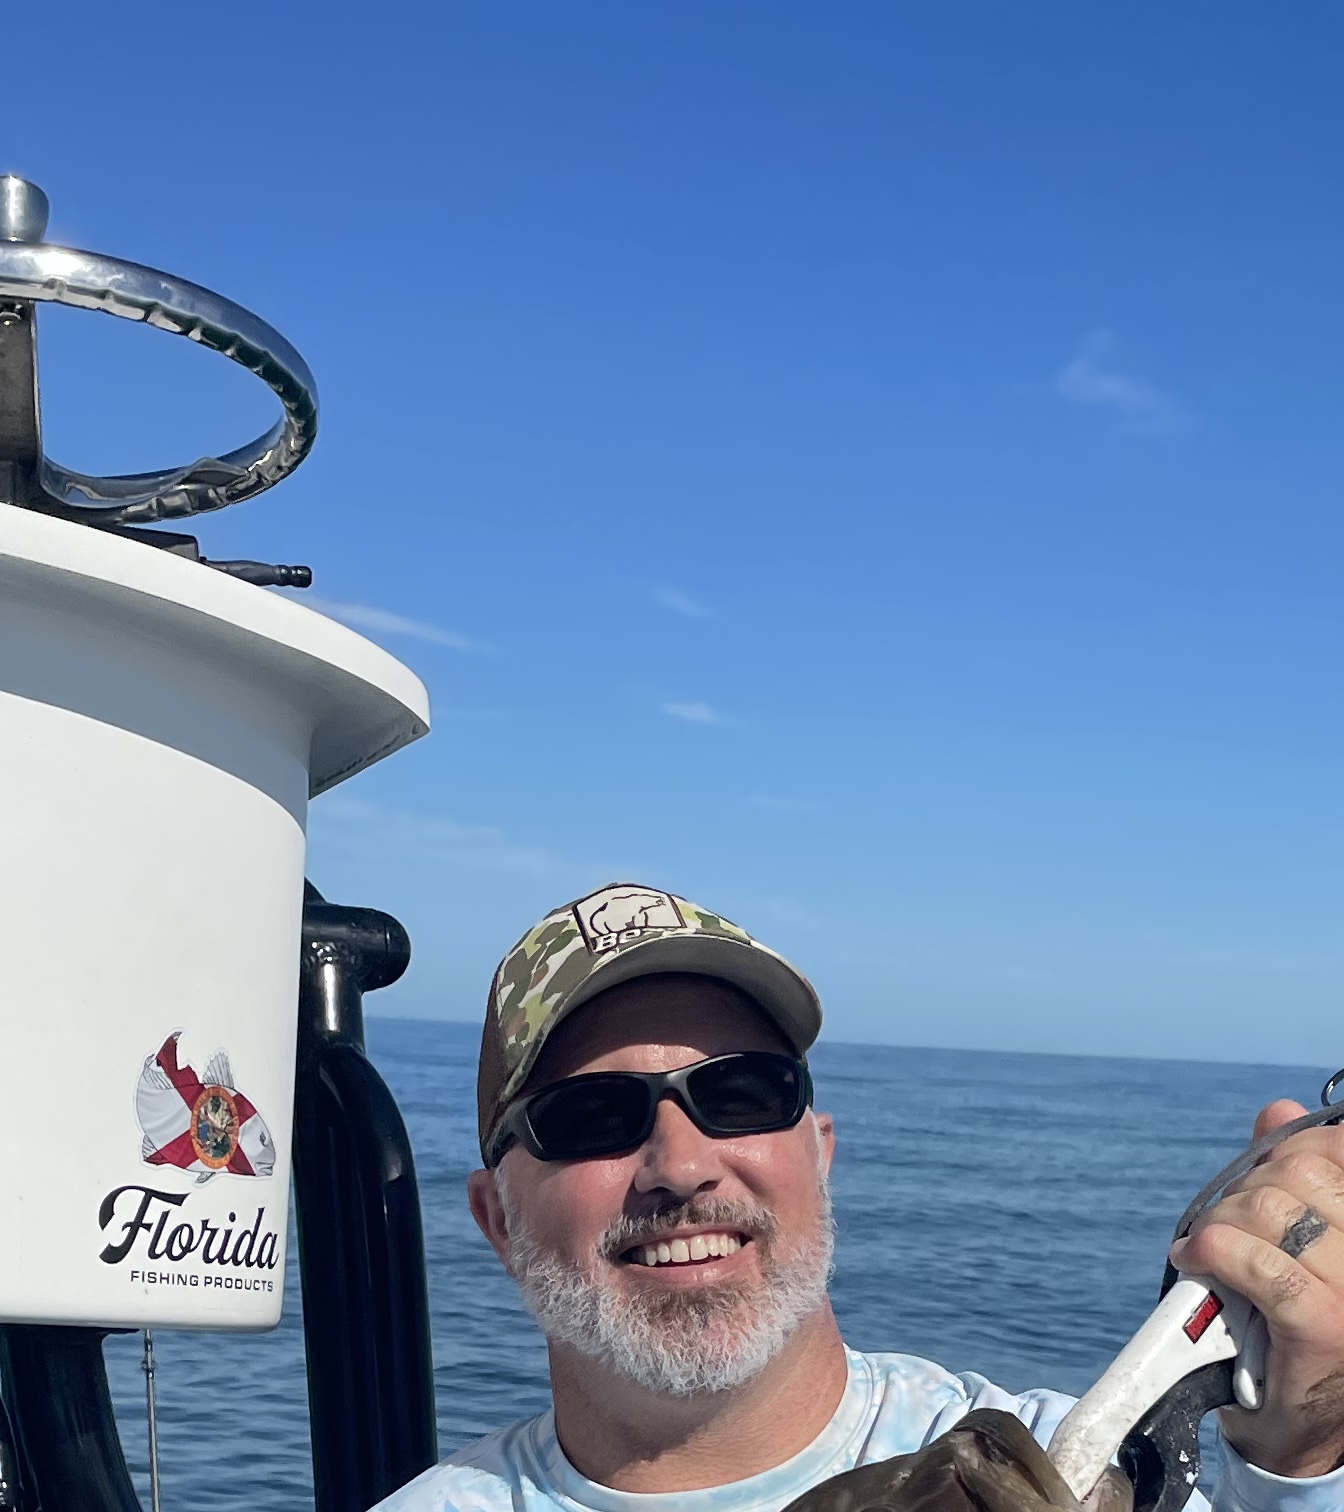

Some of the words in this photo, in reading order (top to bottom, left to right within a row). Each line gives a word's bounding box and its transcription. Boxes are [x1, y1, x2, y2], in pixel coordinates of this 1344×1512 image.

[97, 1184, 280, 1271] Florida
[129, 1269, 200, 1287] FISHING
[203, 1275, 274, 1293] PRODUCTS
